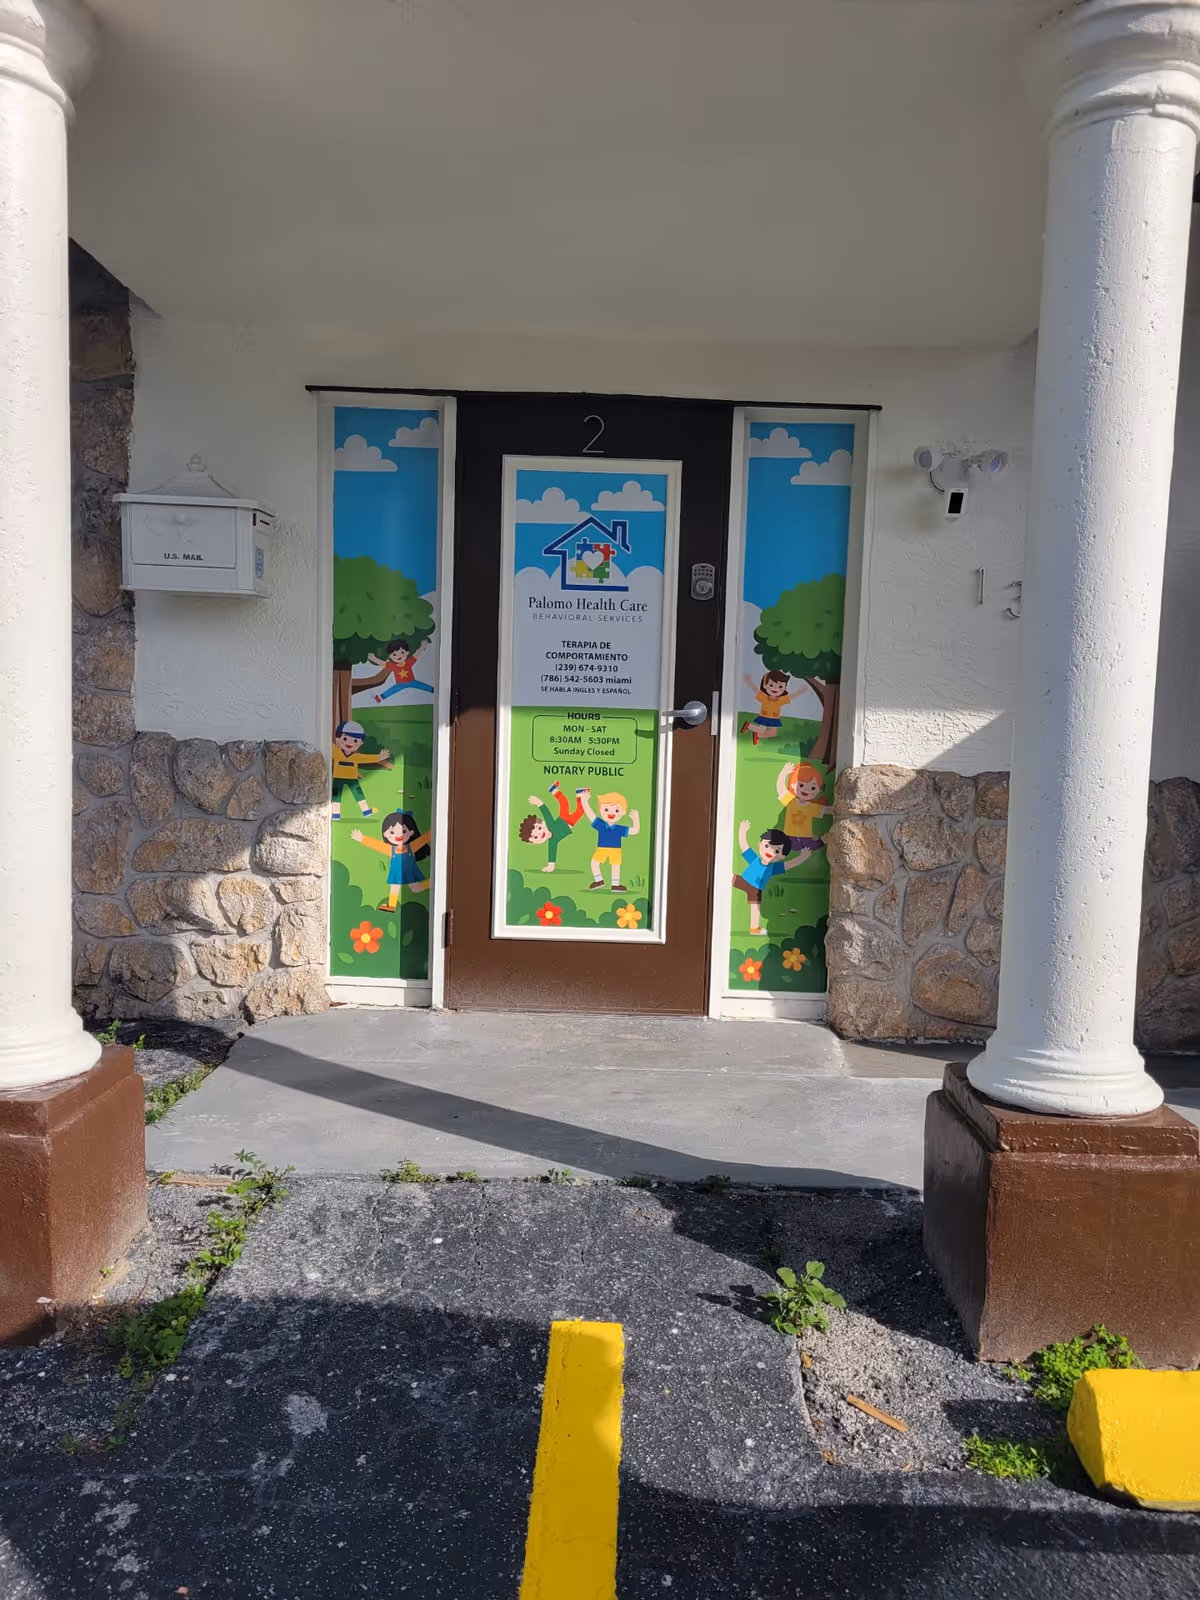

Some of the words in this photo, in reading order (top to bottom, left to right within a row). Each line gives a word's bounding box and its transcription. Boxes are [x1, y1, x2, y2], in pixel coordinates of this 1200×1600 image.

[582, 414, 605, 453] 2
[528, 596, 572, 610] Palomo
[576, 598, 616, 612] Health
[620, 600, 648, 612] Care
[532, 612, 594, 622] BEHAVIORAL
[597, 614, 643, 623] SERVICES
[562, 640, 598, 649] TERAPIA
[546, 652, 628, 662] COMPORTAMIENTO
[555, 664, 576, 672] (239)
[578, 664, 618, 673] 674-9310
[540, 674, 562, 684] (786)
[564, 676, 604, 684] 542-5603
[606, 676, 632, 684] miami
[568, 712, 600, 720] HOURS
[564, 725, 584, 733] MON
[592, 726, 607, 734] SAT
[550, 736, 582, 744] 8:30AM
[588, 737, 620, 745] 5:30PM
[554, 747, 584, 756] Sunday
[587, 748, 614, 756] Closed
[544, 766, 586, 776] NOTARY
[588, 766, 624, 776] PUBLIC
